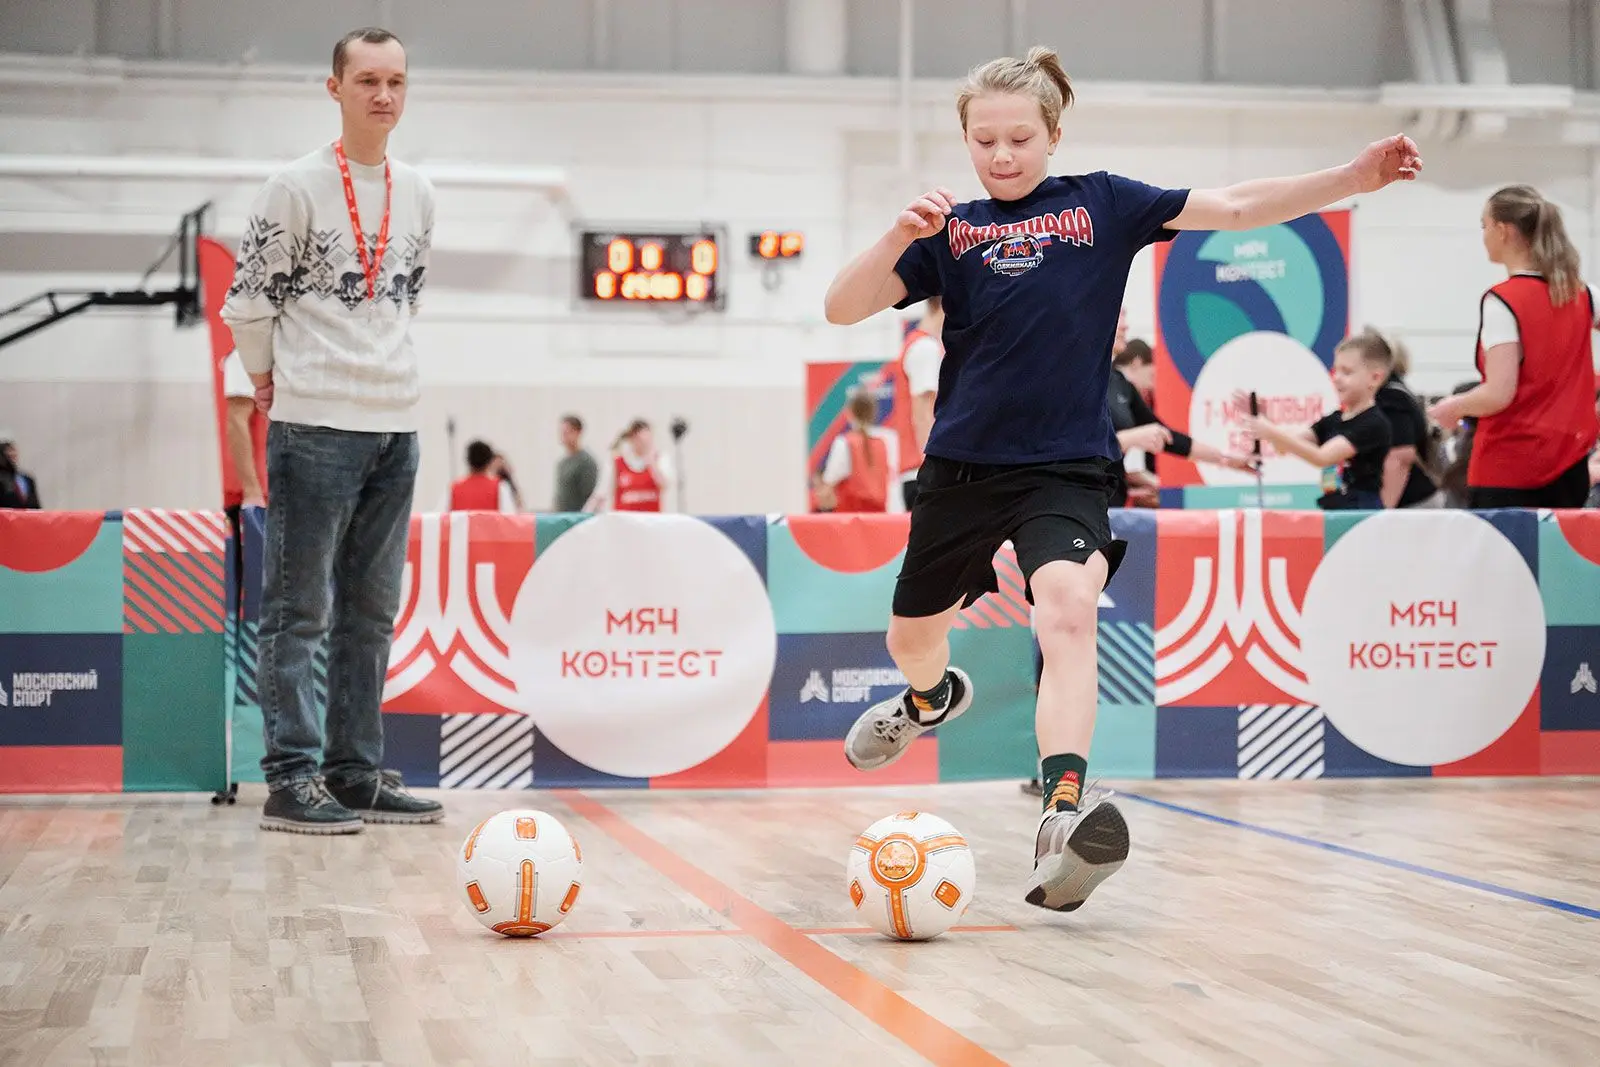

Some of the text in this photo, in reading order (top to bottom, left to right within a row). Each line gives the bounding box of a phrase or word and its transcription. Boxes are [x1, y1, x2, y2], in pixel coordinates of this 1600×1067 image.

[606, 607, 678, 635] МЯЧ
[1390, 600, 1457, 627] МЯЧ
[561, 651, 723, 678] КОНТЕСТ
[1350, 642, 1498, 669] КОНТЕСТ
[13, 669, 98, 690] МОСКОВСКИЙ
[13, 690, 52, 707] СПОРТ
